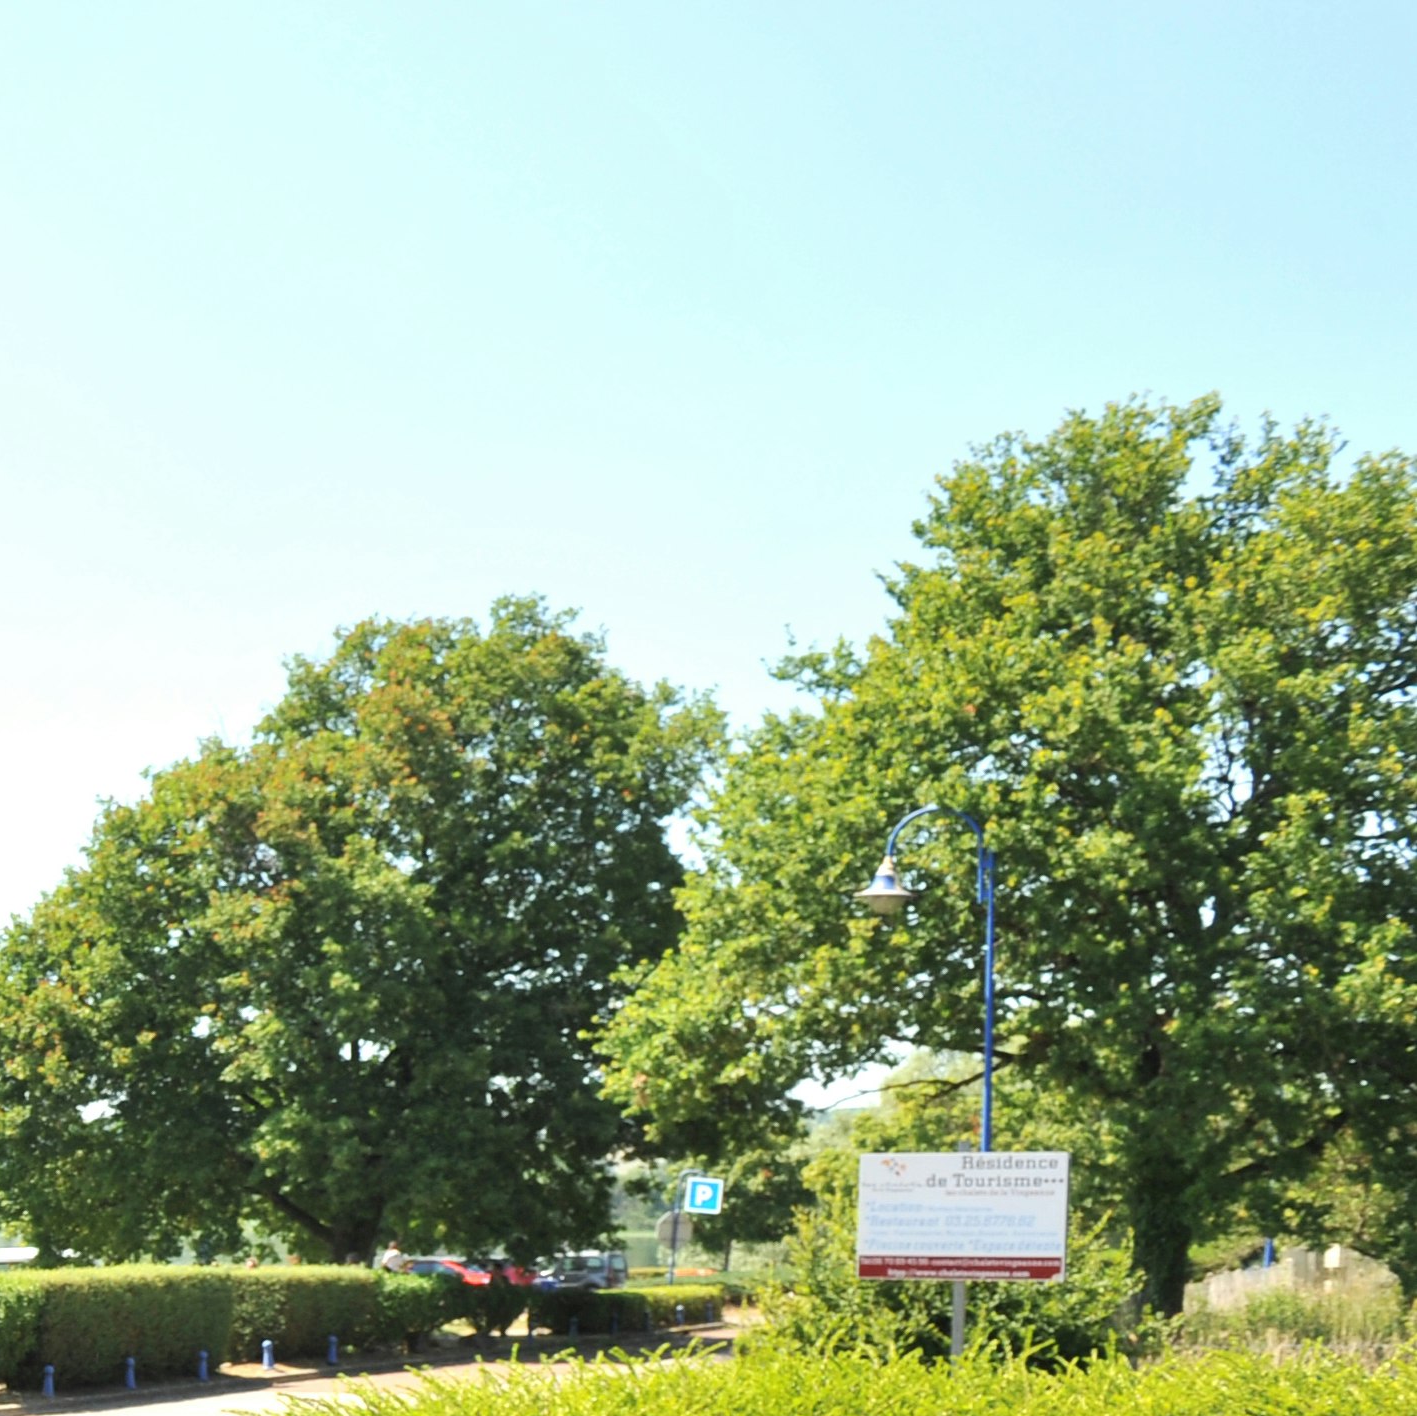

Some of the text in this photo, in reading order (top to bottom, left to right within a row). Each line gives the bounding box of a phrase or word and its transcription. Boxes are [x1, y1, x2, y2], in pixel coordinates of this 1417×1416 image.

[961, 1155, 1058, 1170] Résidence
[926, 1173, 948, 1188] de
[695, 1184, 713, 1206] P
